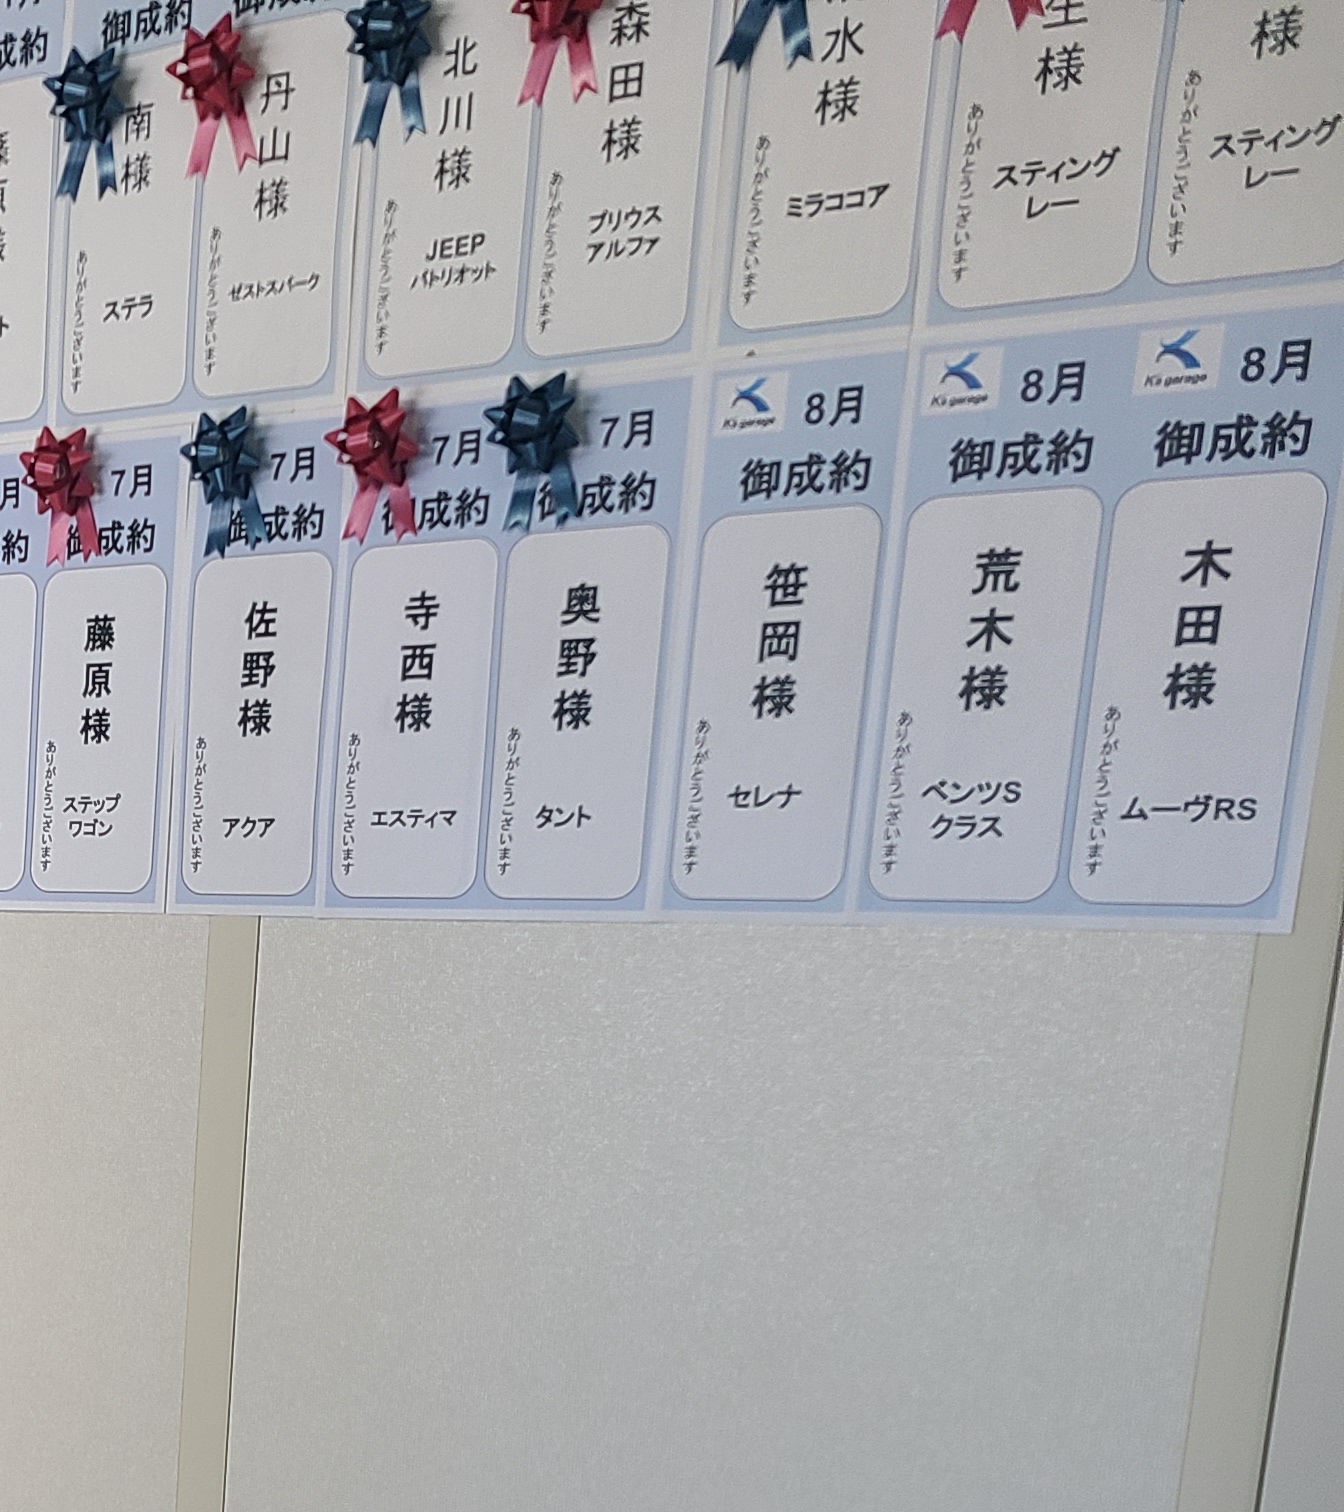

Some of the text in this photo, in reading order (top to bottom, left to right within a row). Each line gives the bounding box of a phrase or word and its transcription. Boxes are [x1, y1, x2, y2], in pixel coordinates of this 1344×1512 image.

[433, 34, 479, 194] 北川様
[121, 102, 154, 195] 南様
[254, 71, 295, 222] 丹山様
[991, 145, 1122, 190] スティング
[785, 182, 891, 218] ミラココア
[1025, 194, 1081, 220] レー
[424, 232, 486, 263] JEEP
[585, 234, 661, 265] アルファ
[102, 293, 154, 324] ステラ
[1019, 359, 1087, 406] 8月
[1239, 337, 1313, 387] 8月
[803, 383, 865, 428] 8月
[431, 429, 481, 466] 7月
[600, 408, 655, 451] 7月
[1153, 409, 1314, 469] 御成約
[270, 445, 316, 485] 7月
[739, 448, 873, 504] 御成約
[948, 426, 1095, 485] 御成約
[110, 462, 153, 500] 7月
[749, 561, 809, 720] 笹岡様
[957, 546, 1024, 713] 荒木様
[1162, 538, 1234, 711] 木田様
[79, 613, 116, 746] 藤原様
[236, 600, 279, 738] 佐野様
[393, 589, 441, 734] 寺西様
[550, 582, 601, 732] 奥野様
[41, 740, 57, 873] ありがとうございます
[62, 792, 122, 815] ステップ
[191, 736, 207, 873] ありがとうございます
[342, 732, 360, 876] ありがとうございます
[497, 729, 521, 876] ありがとうございます
[726, 782, 803, 810] セレナ
[920, 778, 1022, 806] ベンツS
[1118, 793, 1258, 823] ムーヴRS
[68, 817, 114, 838] ワゴン
[221, 815, 276, 839] アクア
[369, 808, 458, 830] エスティマ
[534, 804, 592, 830] タント
[929, 812, 1003, 841] クラス
